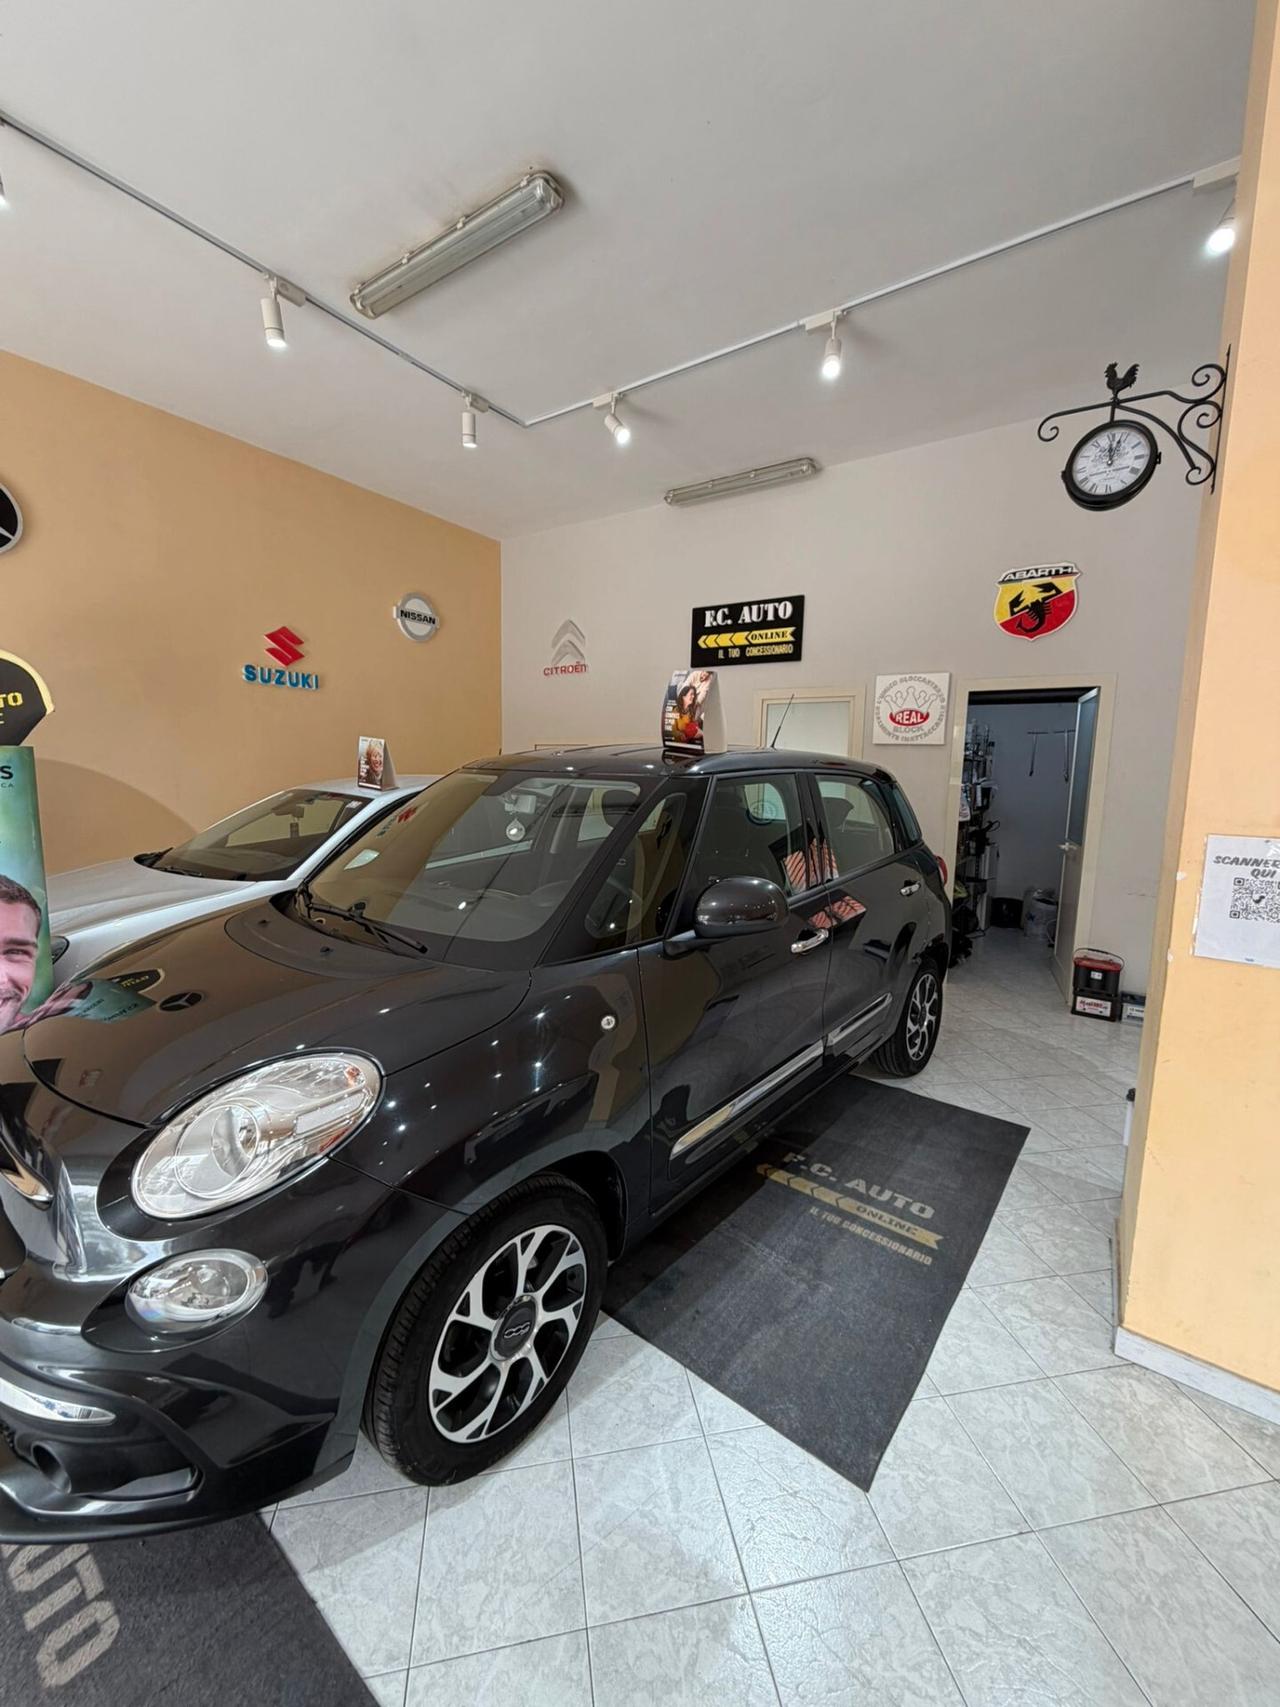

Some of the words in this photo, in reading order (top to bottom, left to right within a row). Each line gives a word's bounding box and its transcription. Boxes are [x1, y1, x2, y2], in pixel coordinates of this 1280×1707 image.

[1003, 566, 1073, 582] ABARTH
[399, 609, 436, 626] NISSAN
[703, 607, 733, 628] F.C.
[737, 600, 794, 625] AUTO
[750, 629, 789, 642] ONLINE
[728, 647, 741, 659] TUO
[745, 643, 794, 658] CONCESSIONARIO
[241, 663, 321, 691] SUZUKI
[895, 709, 926, 725] REAL
[1250, 868, 1278, 879] QUI
[844, 1177, 935, 1220] AUTO
[855, 1204, 919, 1236] ONLINE
[821, 1211, 842, 1226] TUO
[842, 1219, 934, 1267] CONCESSIONARIO
